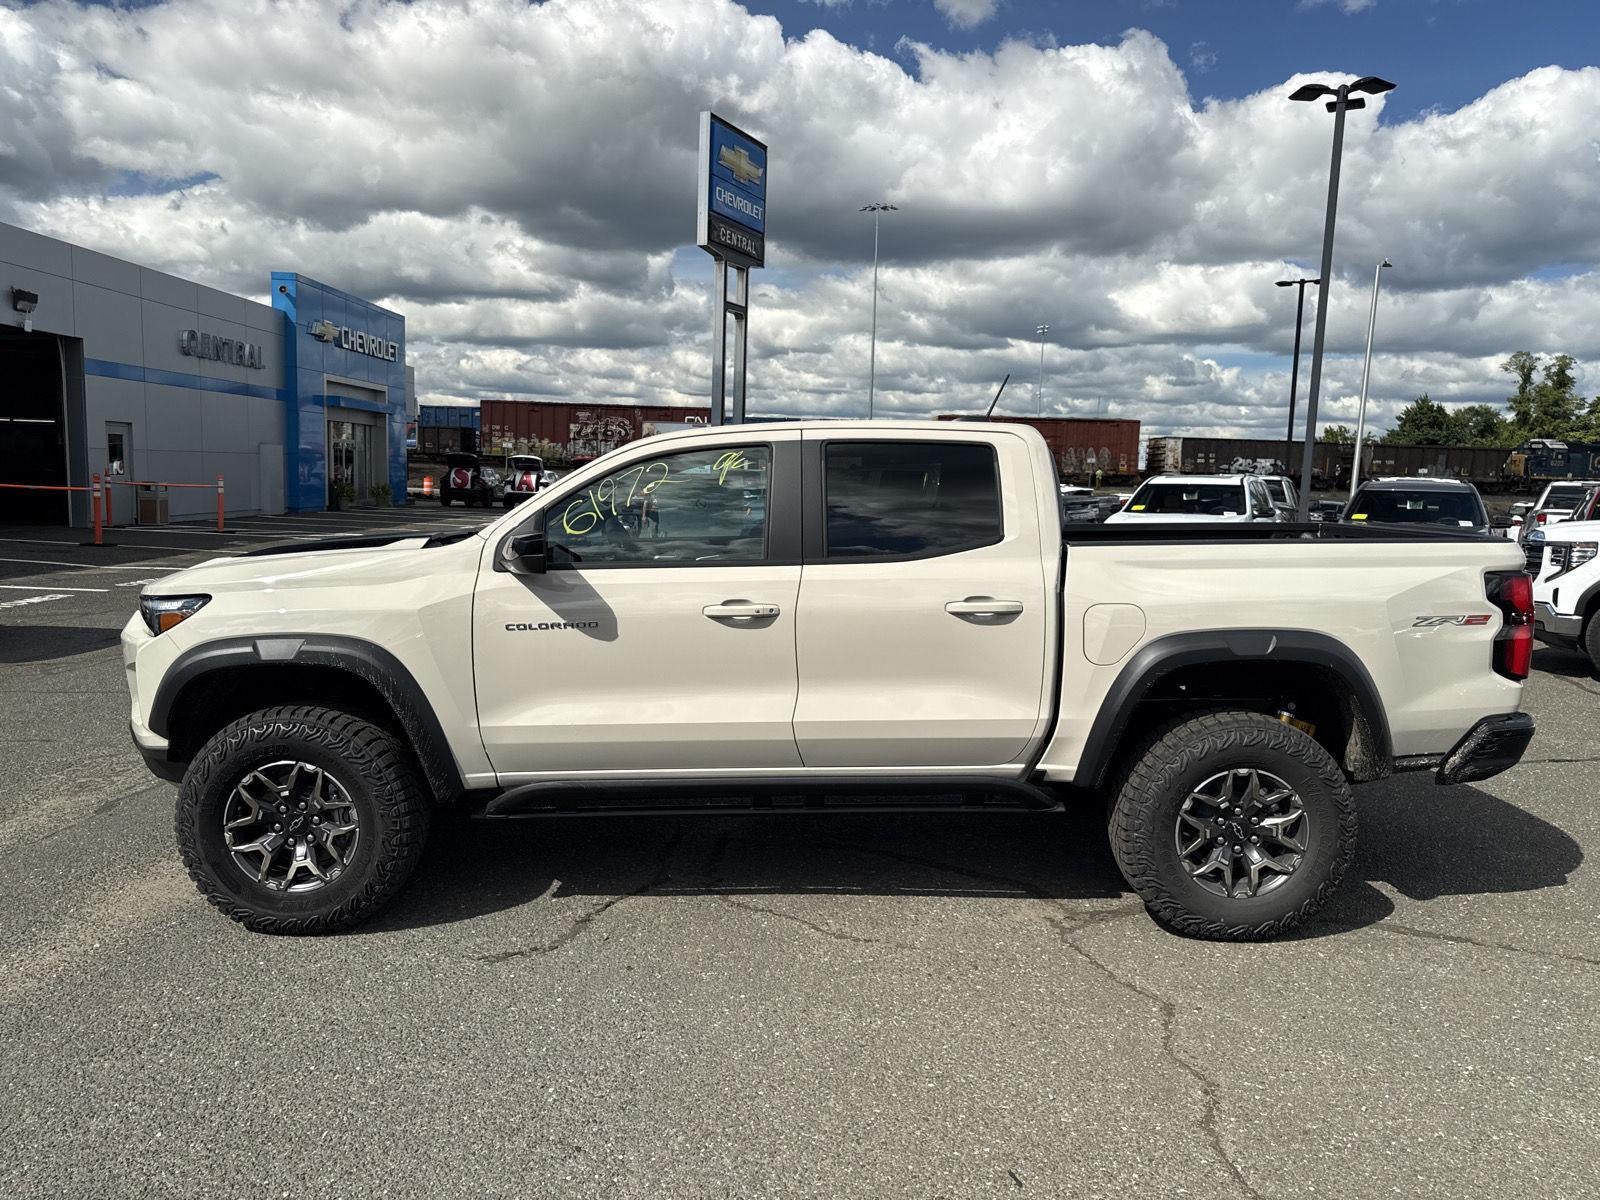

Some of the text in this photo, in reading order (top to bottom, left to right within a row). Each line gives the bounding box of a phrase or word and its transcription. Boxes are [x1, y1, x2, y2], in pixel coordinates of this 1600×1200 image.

[716, 187, 762, 220] CHEVROLET
[720, 227, 756, 254] CENTRAL
[341, 325, 399, 362] CHEVROLET
[517, 470, 535, 491] A
[562, 462, 693, 535] 61972
[505, 621, 599, 631] COLORADO
[1412, 614, 1492, 627] ZR2
